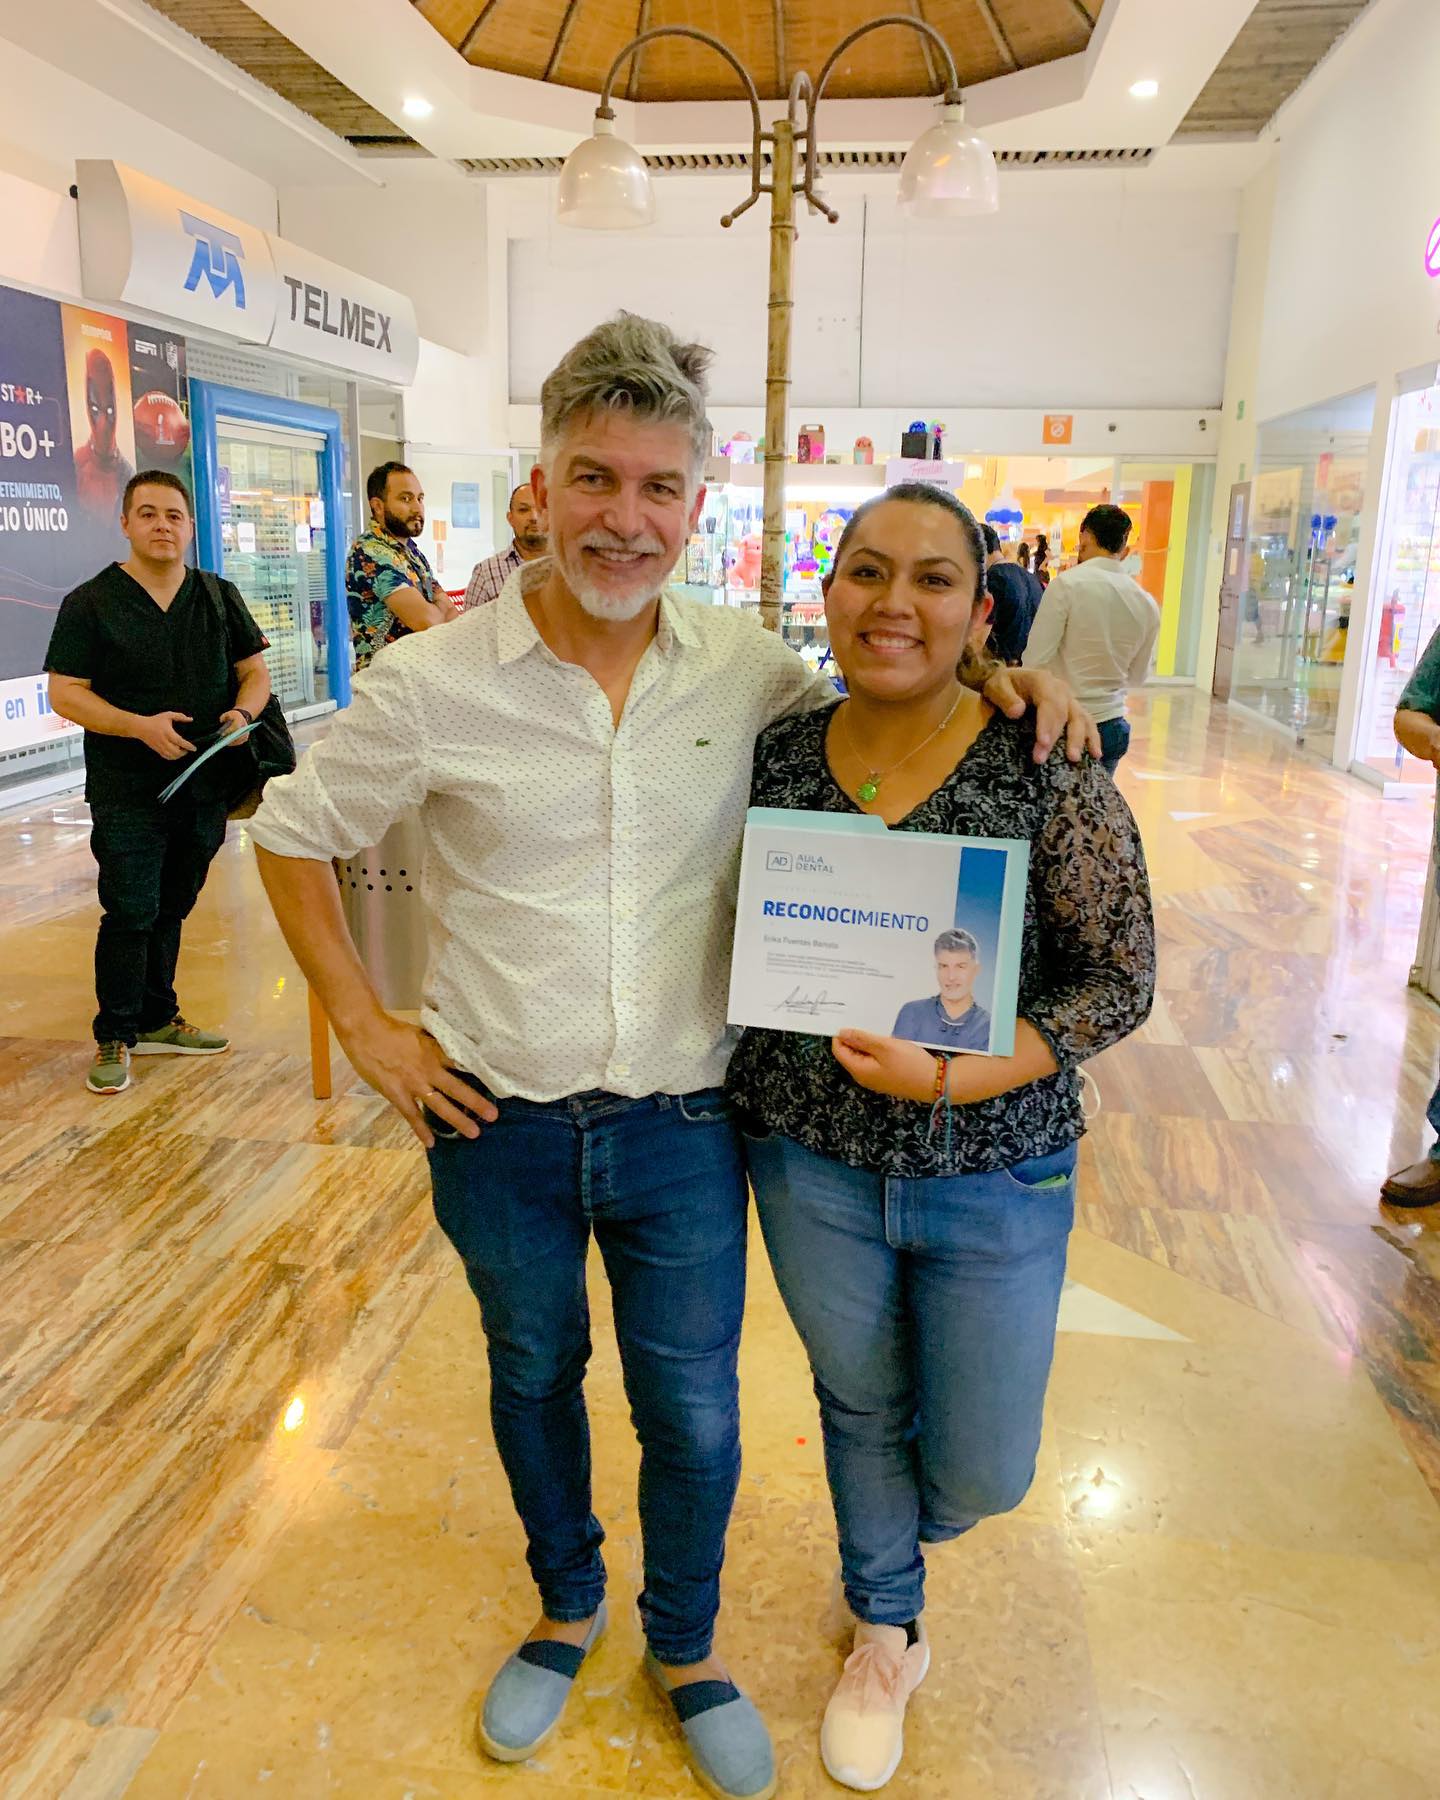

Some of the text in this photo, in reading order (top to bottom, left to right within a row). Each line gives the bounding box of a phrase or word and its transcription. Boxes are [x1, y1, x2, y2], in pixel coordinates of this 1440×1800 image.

[284, 275, 392, 353] TELMEX
[135, 340, 157, 356] ESPN
[23, 501, 68, 531] ÚNICO
[5, 697, 25, 719] en
[796, 862, 833, 873] DENTAL
[797, 854, 824, 864] AULA
[763, 900, 929, 932] RECONOCIMIENTO
